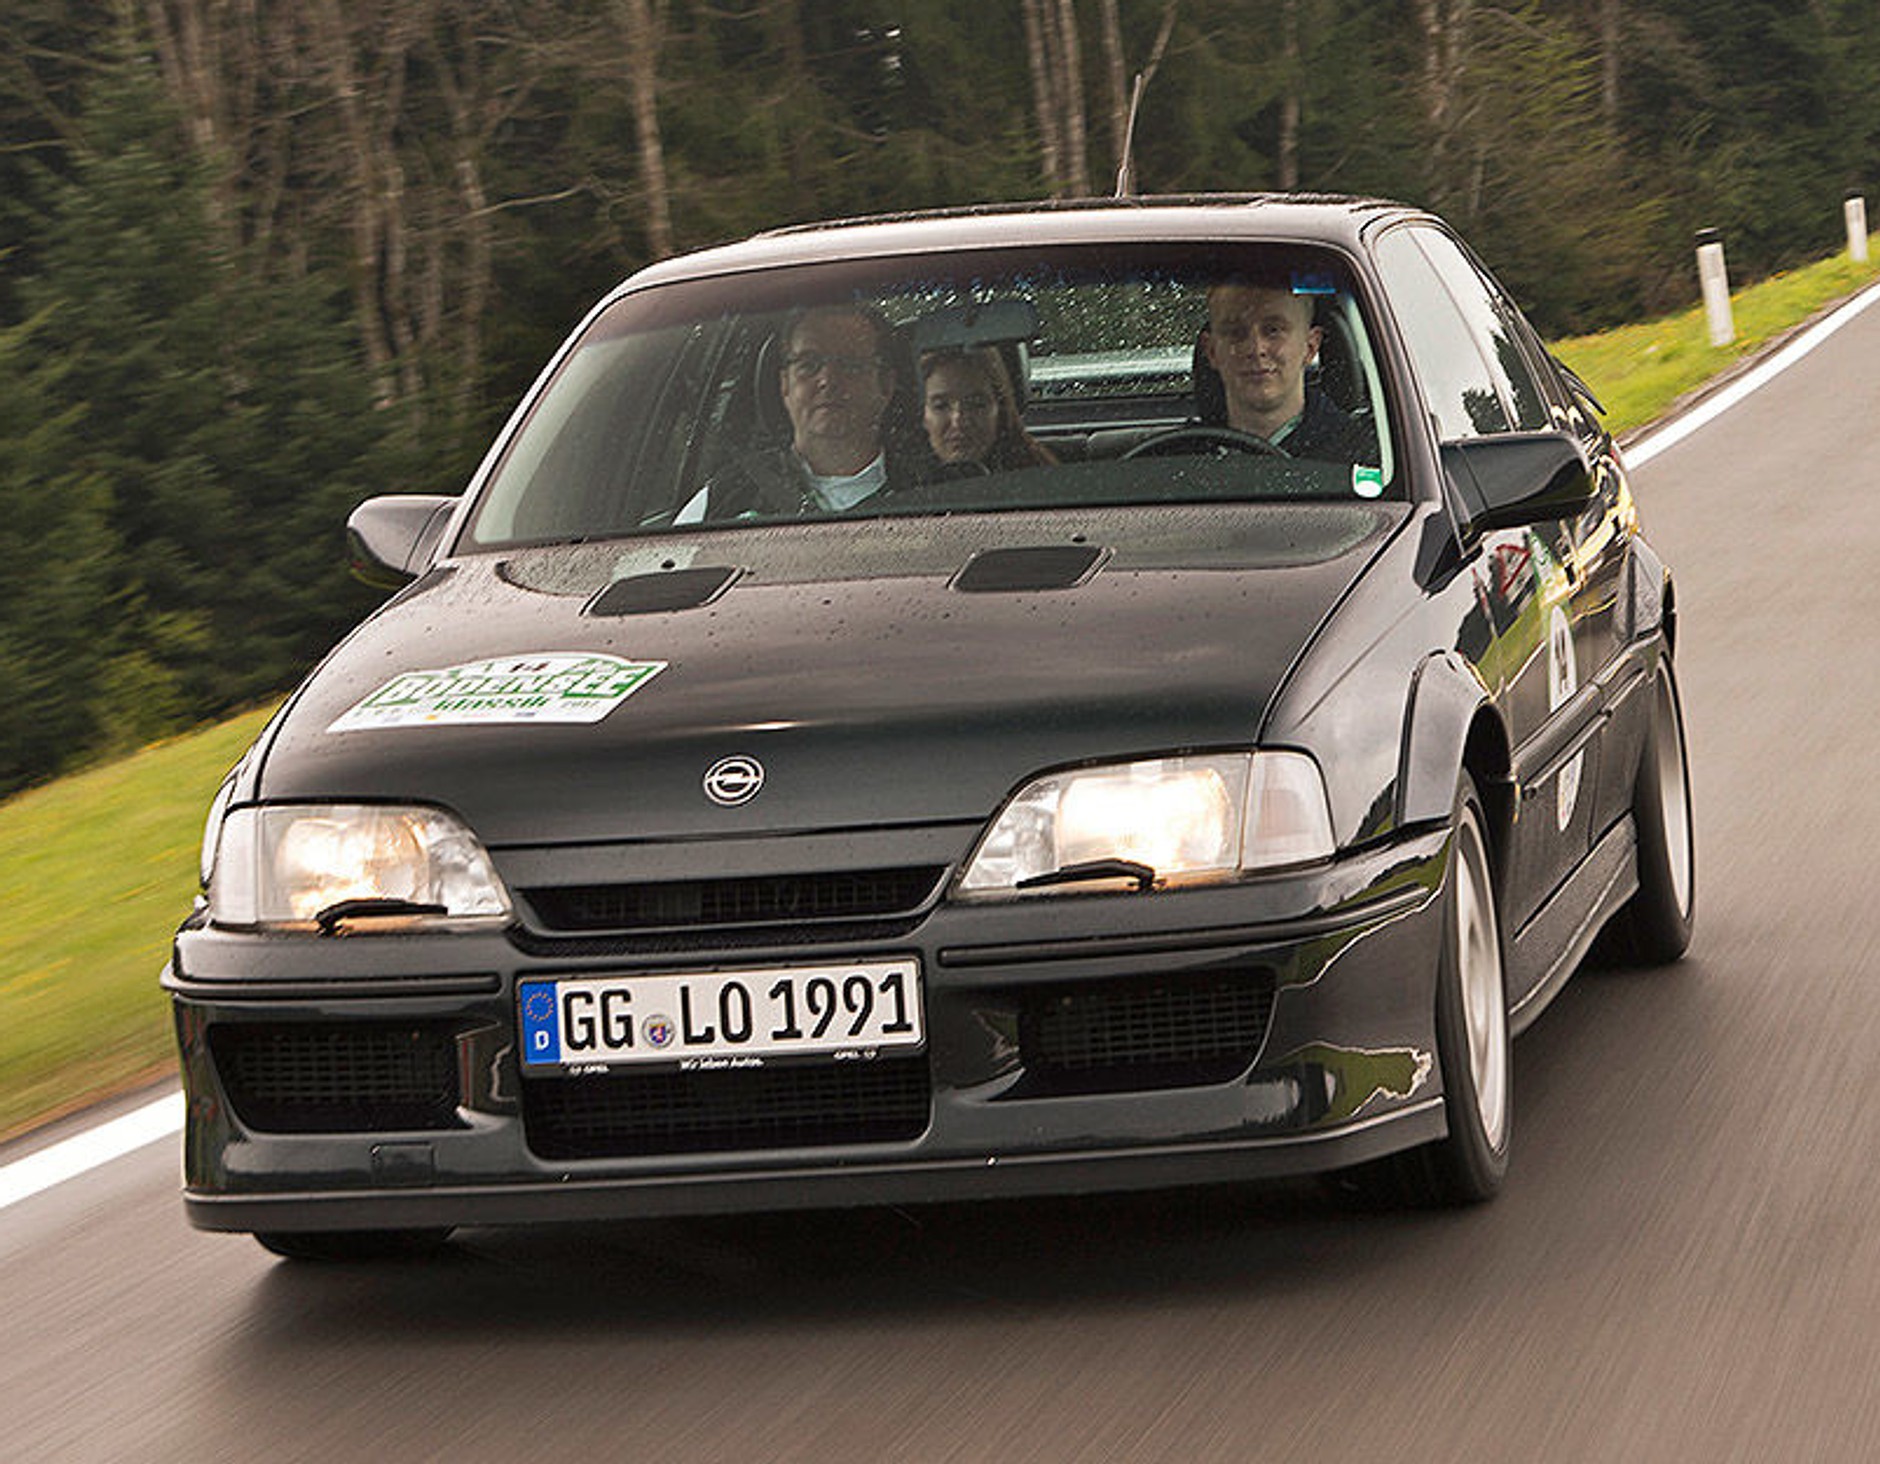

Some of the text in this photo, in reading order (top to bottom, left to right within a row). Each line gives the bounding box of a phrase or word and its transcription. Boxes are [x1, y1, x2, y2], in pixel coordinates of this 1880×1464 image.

[563, 972, 914, 1052] GG LO 1991
[534, 1030, 550, 1051] D
